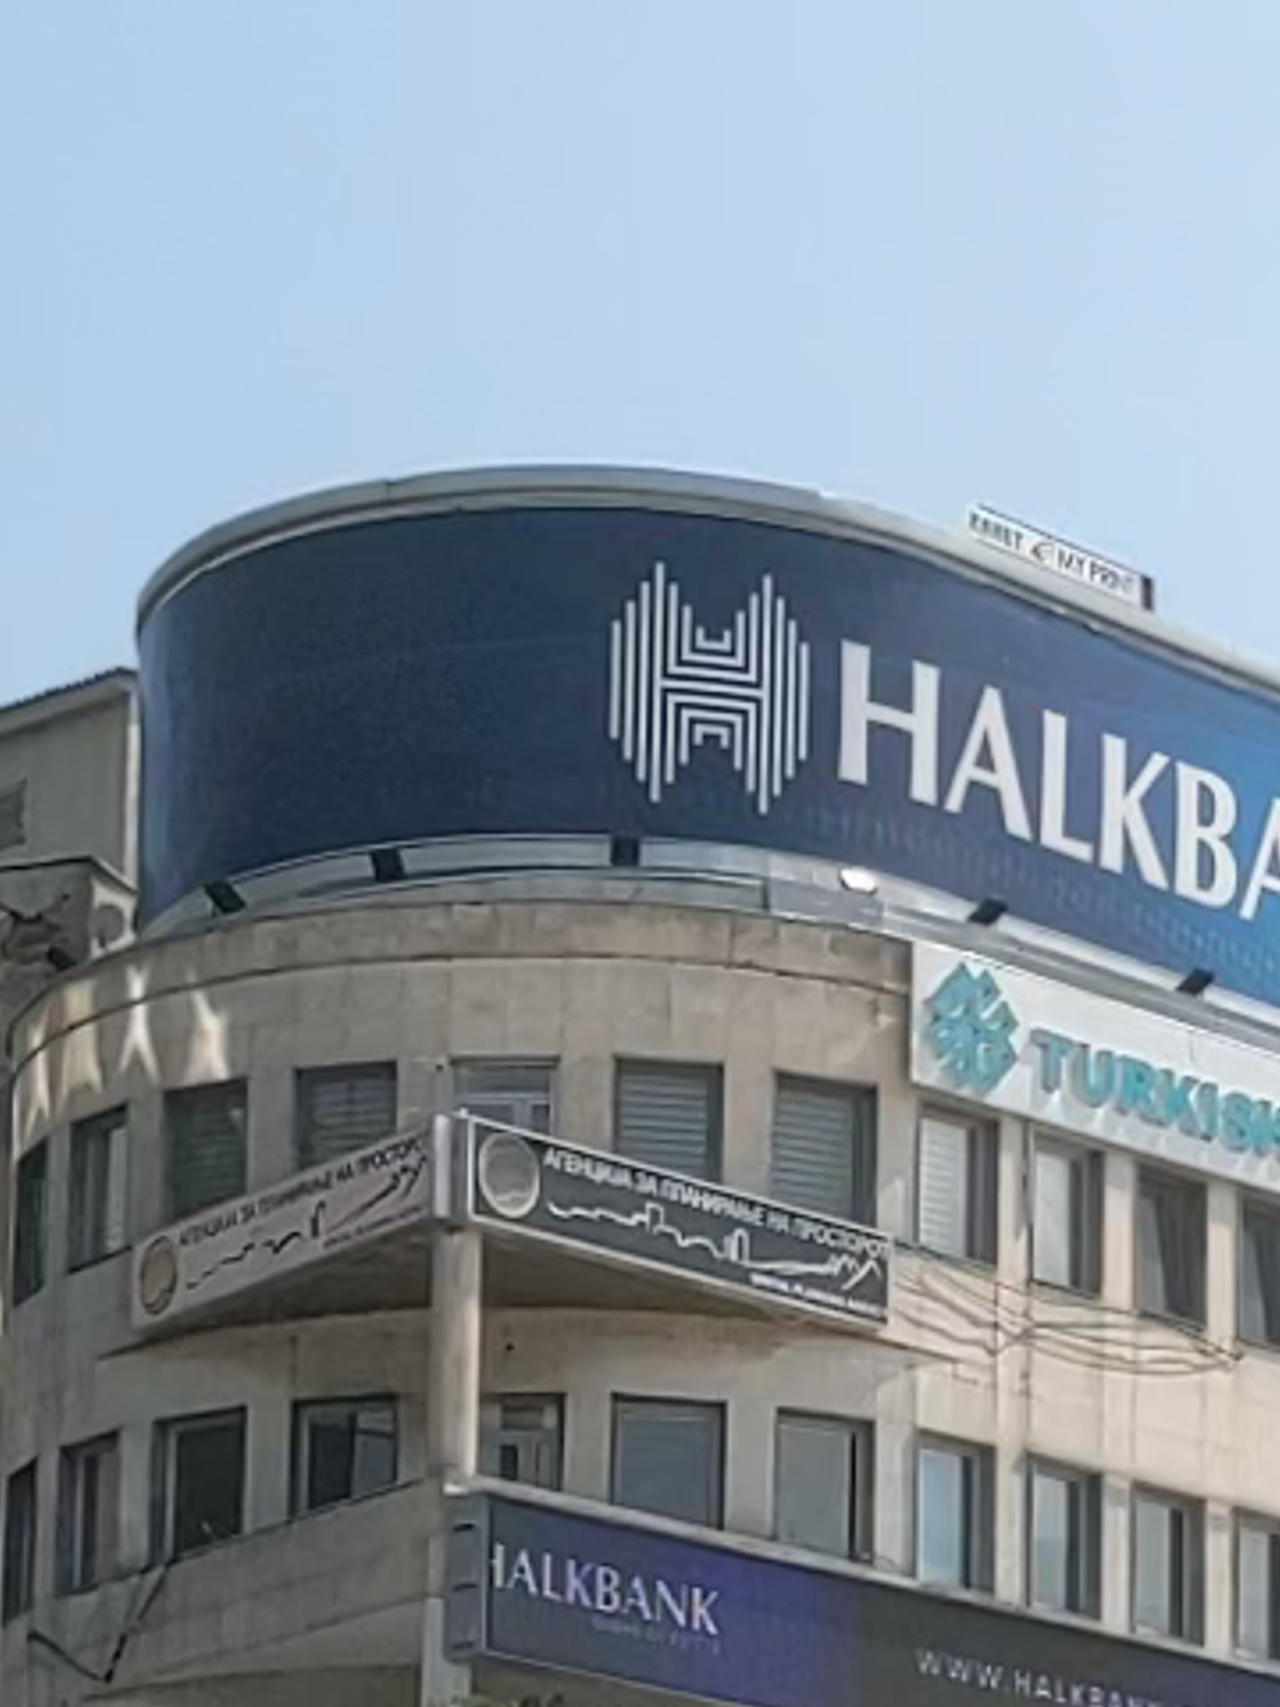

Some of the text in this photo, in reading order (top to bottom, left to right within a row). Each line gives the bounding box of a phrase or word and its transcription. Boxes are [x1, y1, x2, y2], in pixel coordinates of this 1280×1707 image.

[542, 1147, 634, 1192] АГЕНЦИЈА
[631, 1170, 659, 1196] ЗА
[766, 1208, 791, 1235] НА
